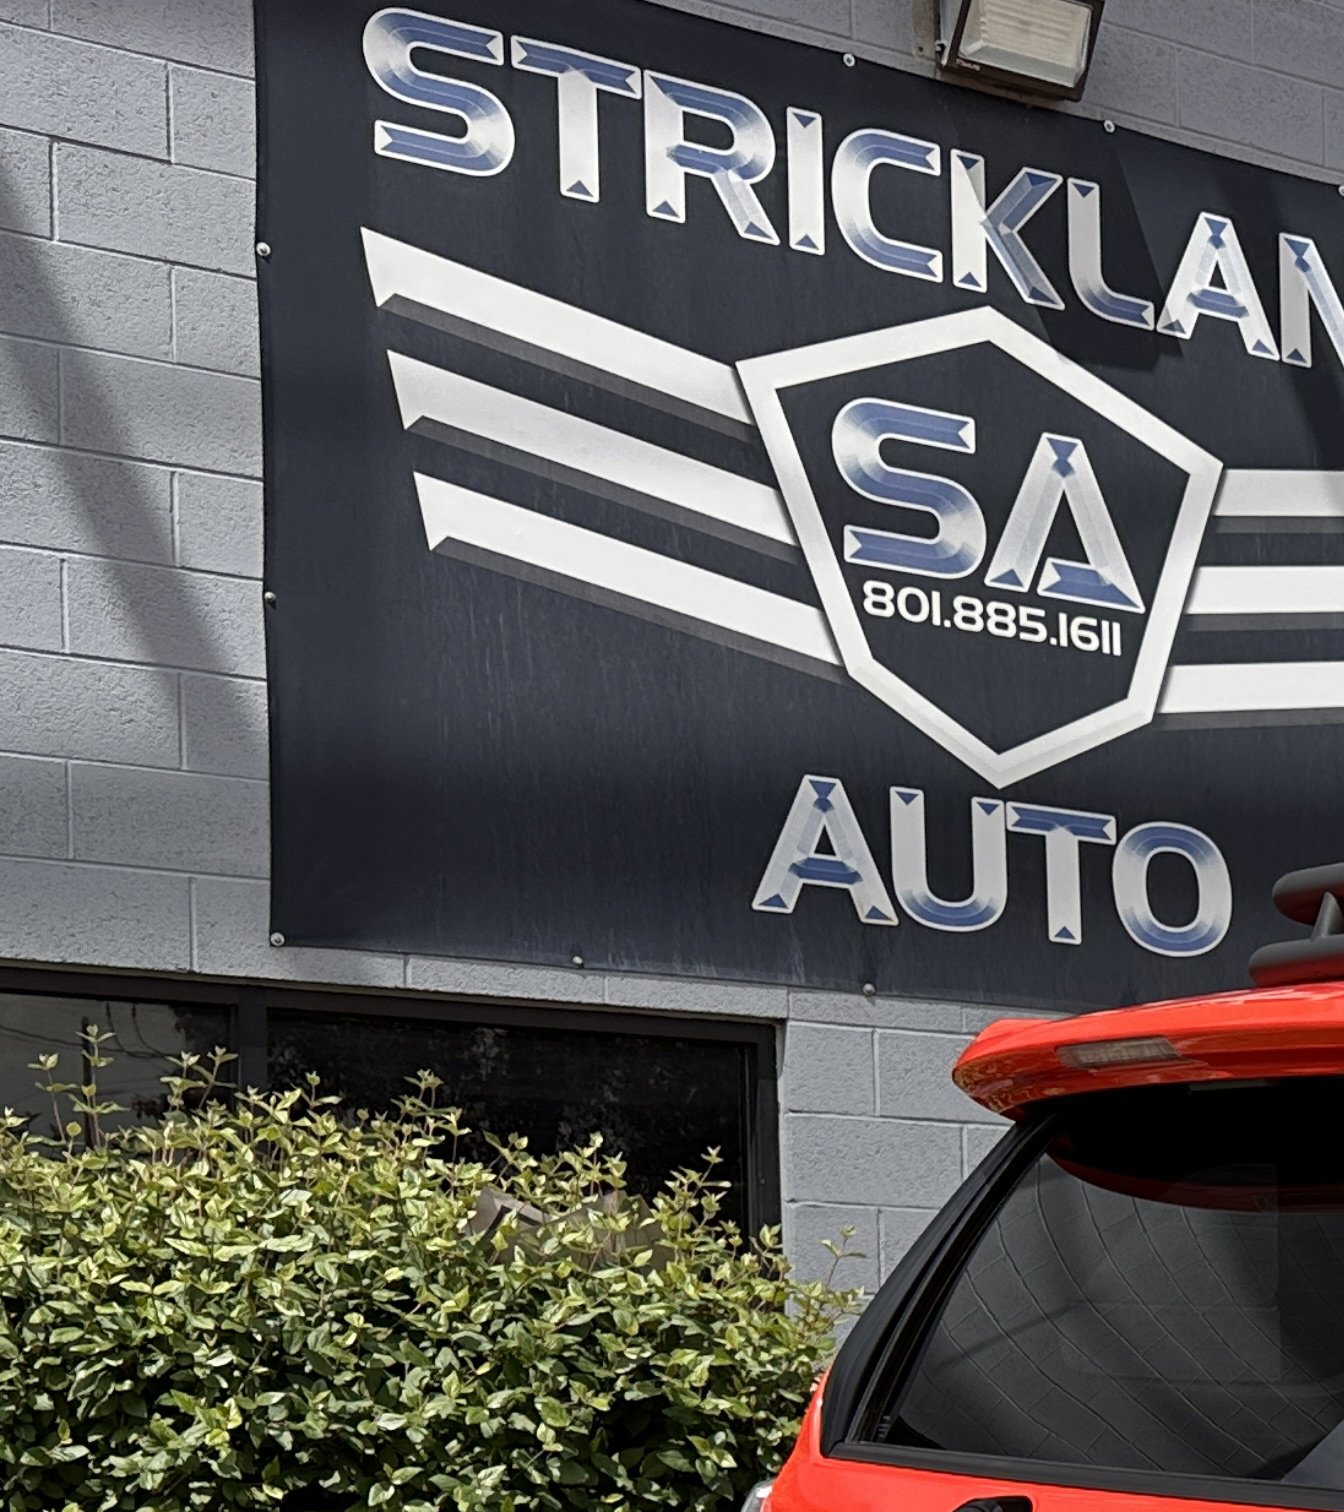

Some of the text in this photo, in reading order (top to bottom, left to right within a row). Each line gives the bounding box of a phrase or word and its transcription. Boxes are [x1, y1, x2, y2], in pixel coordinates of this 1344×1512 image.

[830, 397, 1146, 613] SA
[861, 580, 1123, 656] 801.885.1611
[751, 774, 1233, 957] AUTO
